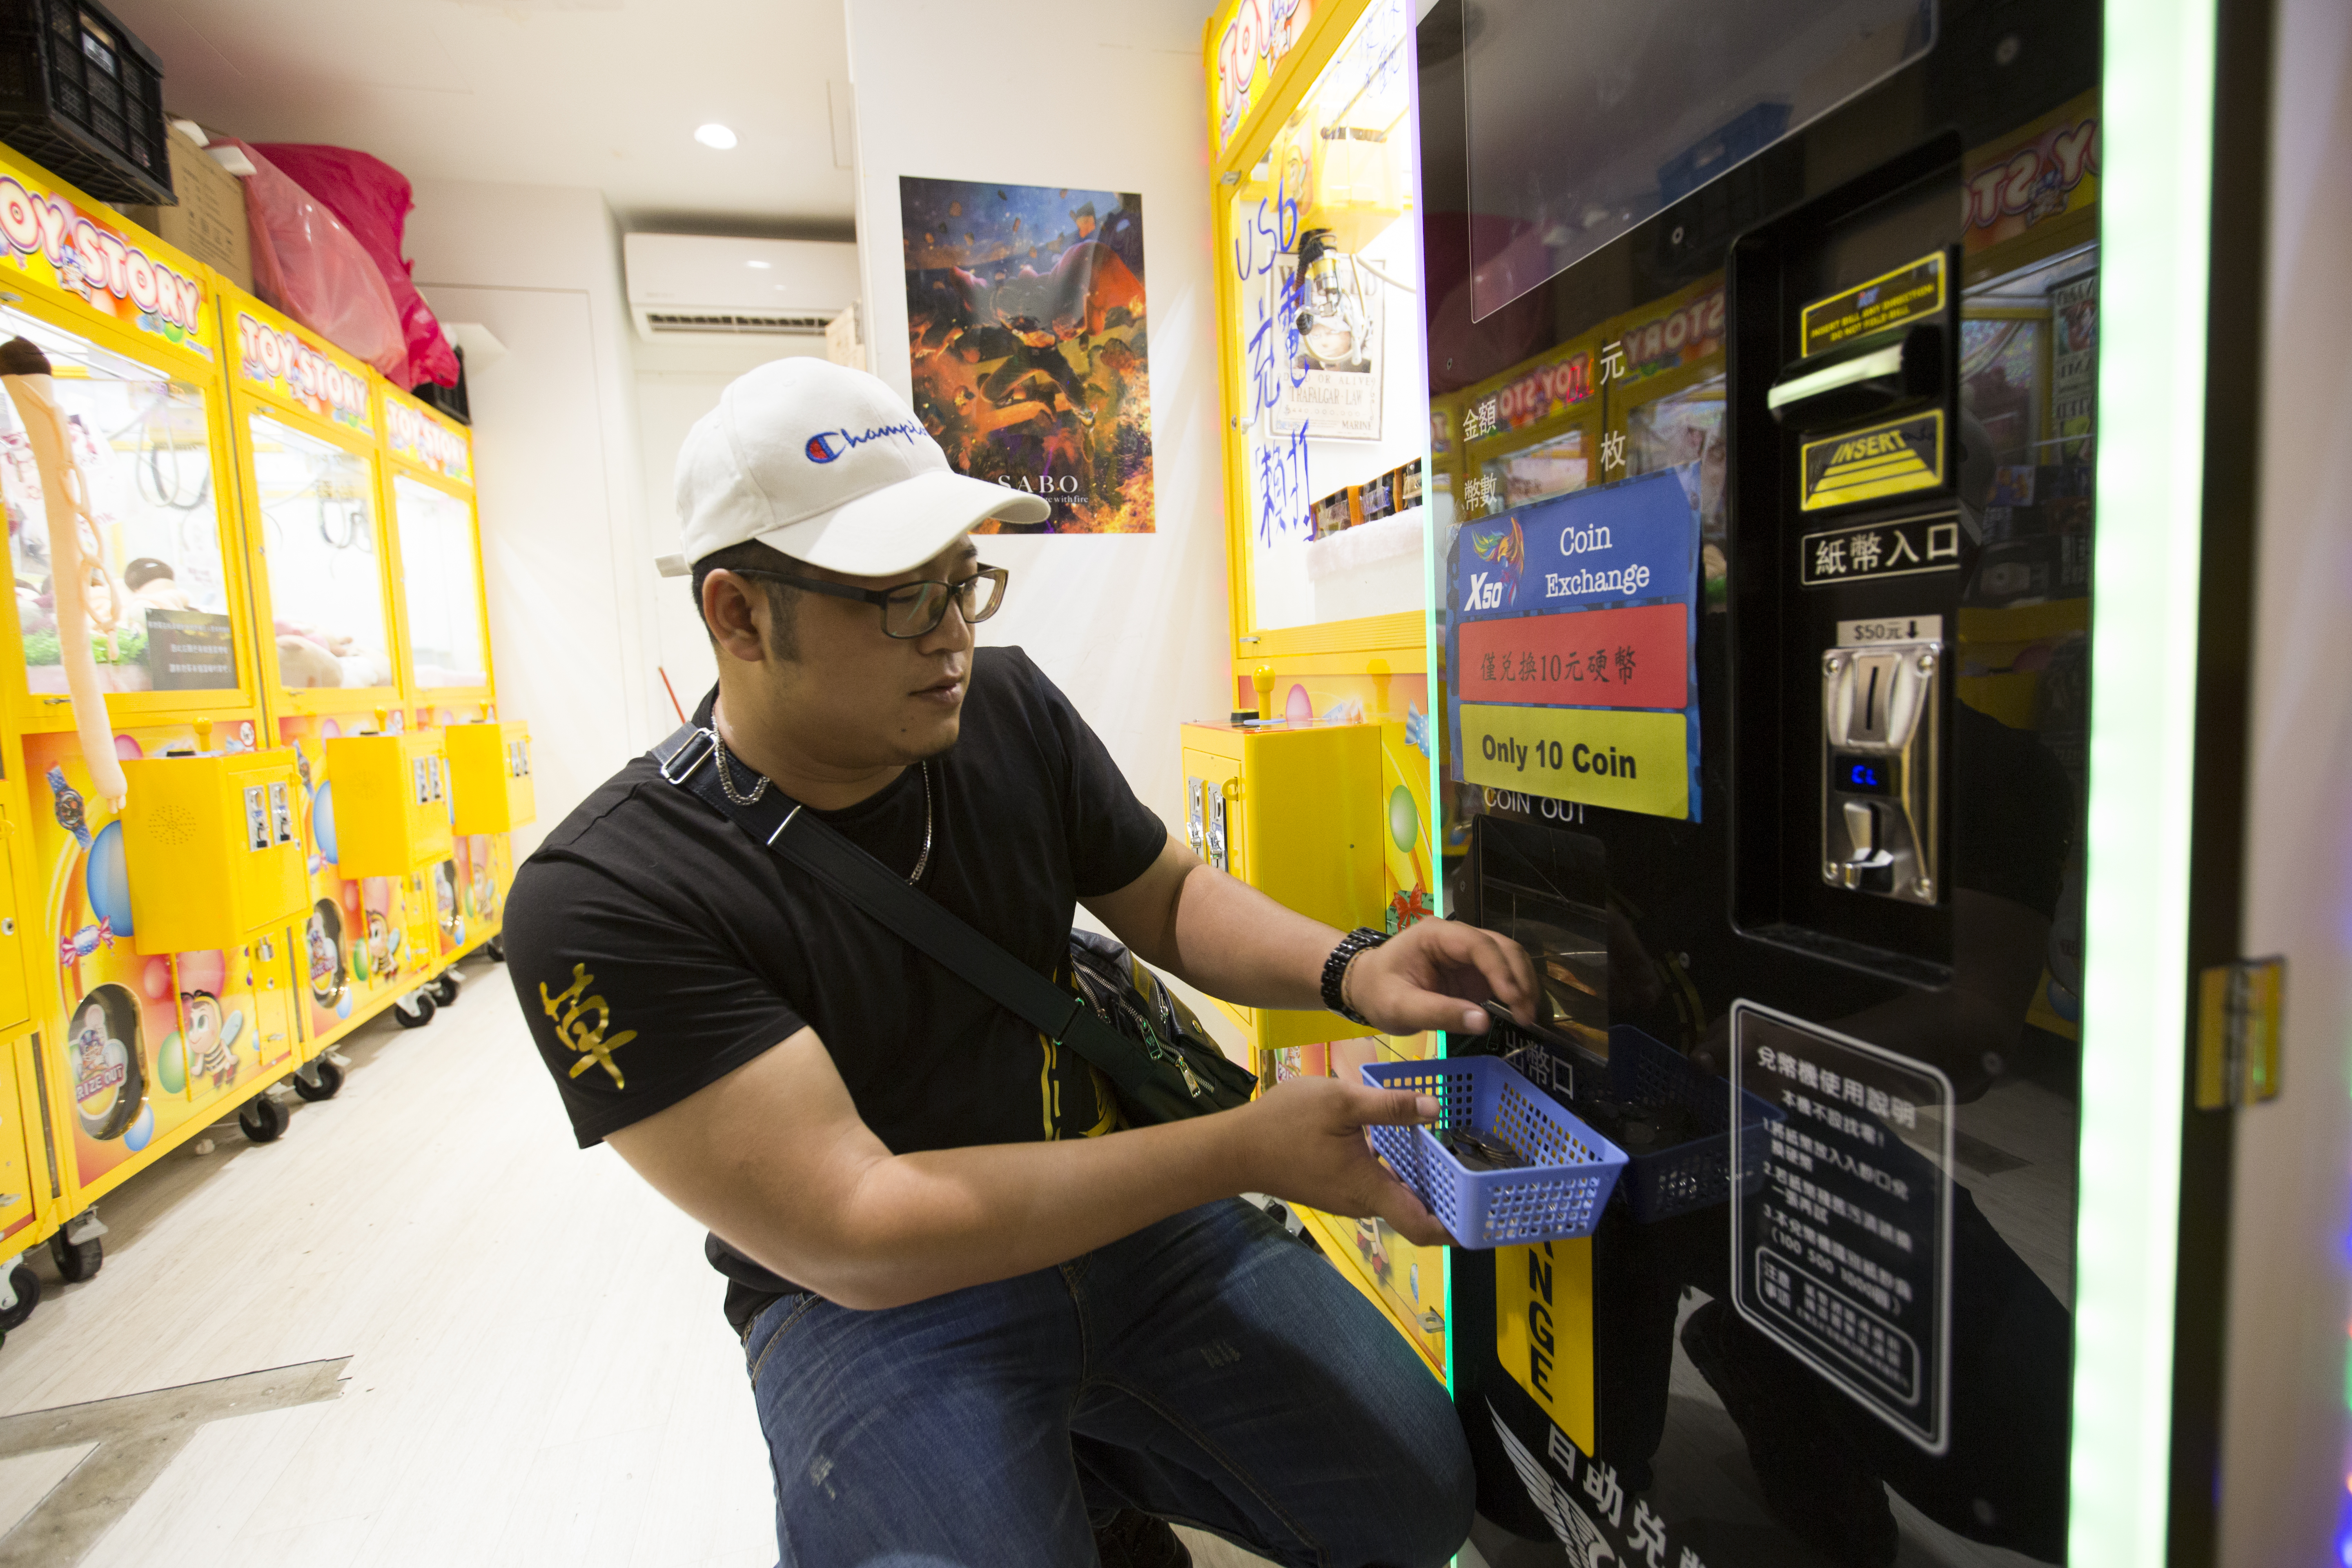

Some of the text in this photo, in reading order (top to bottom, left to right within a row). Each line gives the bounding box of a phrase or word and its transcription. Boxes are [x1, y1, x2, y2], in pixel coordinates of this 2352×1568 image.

[73, 216, 200, 335] STORY
[1810, 319, 1840, 339] INSERT
[1841, 312, 1860, 327] BILL
[238, 311, 369, 421] TOY STORY
[1318, 374, 1331, 384] OR
[1339, 375, 1371, 386] ALIVE
[1600, 341, 1625, 385] 元
[1289, 385, 1364, 405] TRAFALGAR LAW
[385, 397, 468, 472] TOY STORY
[1342, 420, 1372, 430] MARINE
[1463, 399, 1497, 442] 金額
[805, 419, 930, 464] Champio
[1600, 430, 1626, 471] 枚
[1831, 430, 1906, 465] INSERT
[998, 475, 1078, 494] SABO
[1464, 472, 1497, 511] 幣數
[1560, 523, 1613, 556] Coin
[1815, 522, 1958, 575] 紙幣入口
[1545, 564, 1650, 598] Exchange
[1854, 621, 1902, 640] $50元
[1482, 735, 1637, 779] Only 10 Coin
[1484, 786, 1531, 814] COIN
[105, 1065, 124, 1087] OUT
[1505, 1031, 1574, 1100] 出幣口
